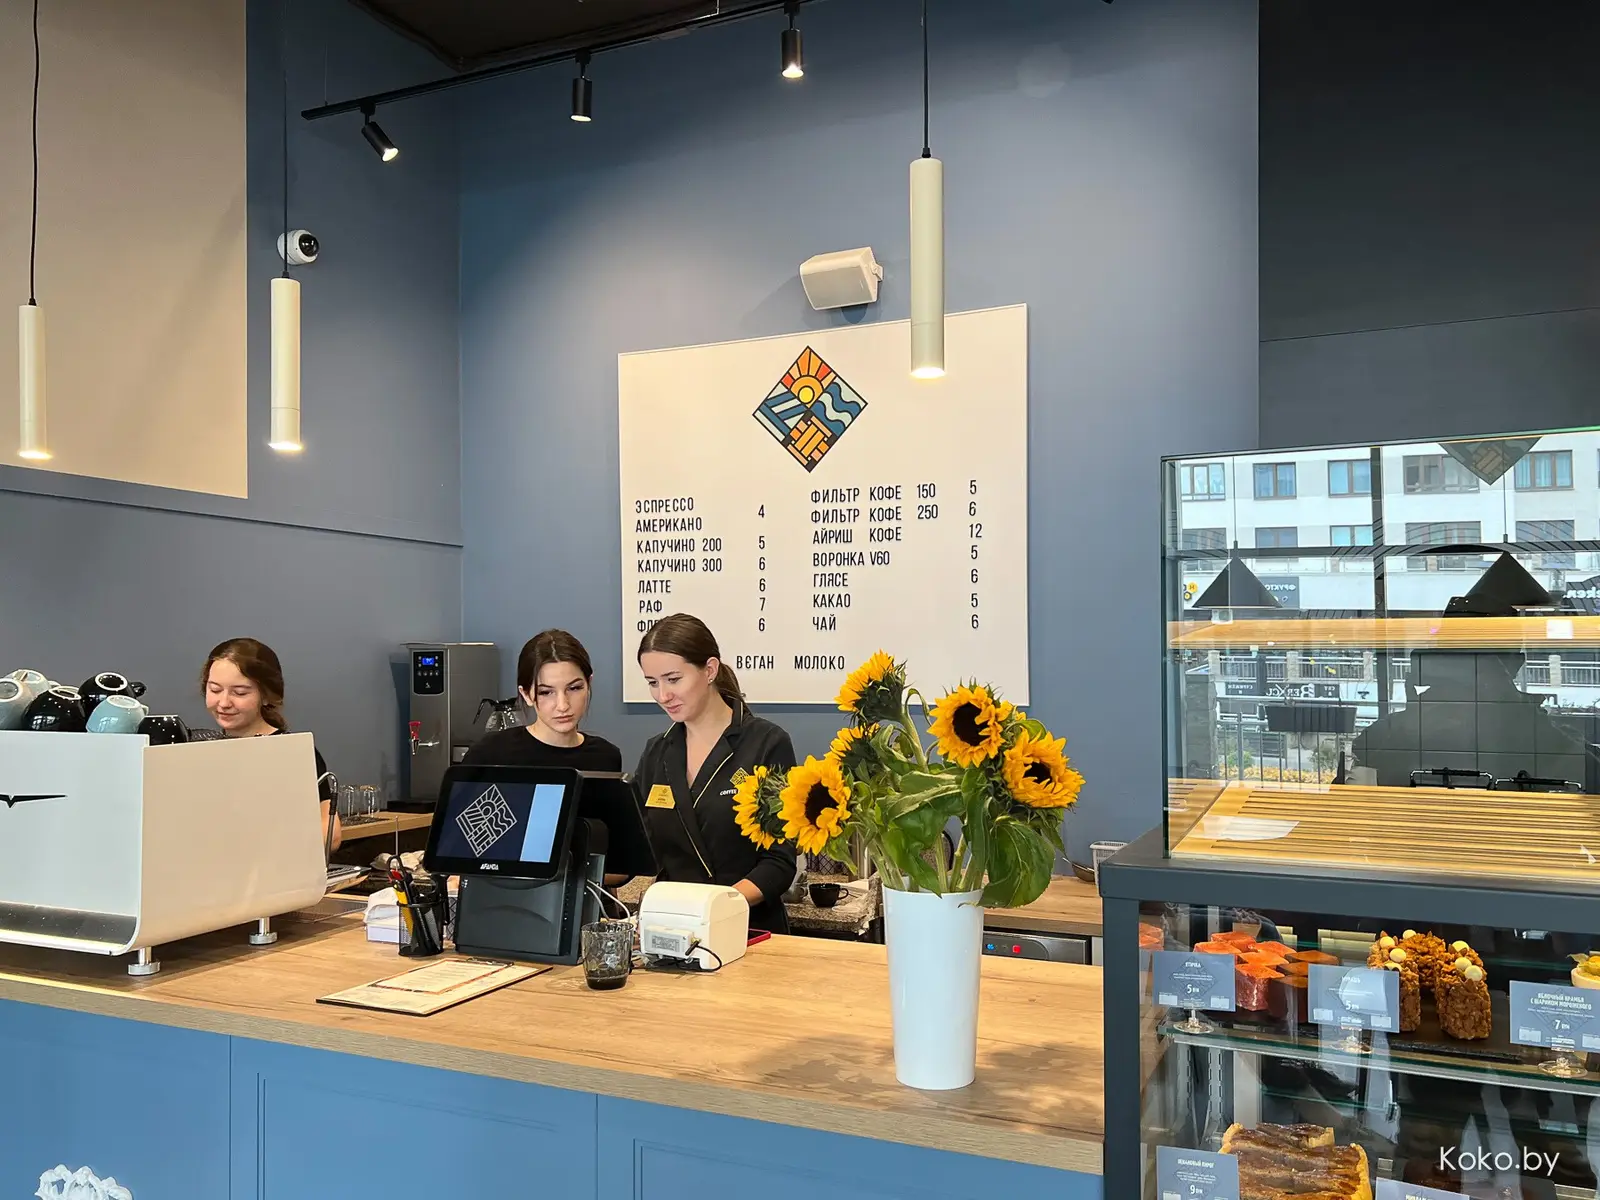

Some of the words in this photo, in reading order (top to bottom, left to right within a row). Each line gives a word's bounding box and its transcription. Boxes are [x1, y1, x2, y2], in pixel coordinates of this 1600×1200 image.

[810, 487, 860, 504] ФИЛЬТР
[869, 485, 902, 501] КОФЕ
[916, 483, 936, 499] 150
[969, 480, 977, 495] 5
[635, 497, 695, 514] ЭСПРЕССО
[757, 504, 765, 518] 4
[810, 508, 860, 524] ФИЛЬТР
[869, 506, 902, 522] КОФЕ
[917, 504, 939, 520] 250
[968, 501, 977, 516] 6
[635, 517, 703, 533] АМЕРИКАНО
[812, 527, 853, 545] АЙРИШ
[869, 526, 902, 543] КОФЕ
[968, 523, 983, 539] 12
[636, 538, 696, 554] КАПУЧИНО
[701, 537, 722, 553] 200
[758, 535, 766, 550] 5
[812, 551, 865, 567] ВОРОНКА
[869, 550, 891, 566] V60
[970, 544, 978, 560] 5
[637, 558, 696, 574] КАПУЧИНО
[701, 557, 723, 573] 300
[758, 556, 766, 571] 6
[637, 579, 672, 594] ЛАТТЕ
[758, 577, 766, 593] 6
[813, 572, 849, 588] ГЛЯСЕ
[970, 568, 979, 584] 6
[638, 599, 663, 614] РАФ
[759, 597, 766, 612] 7
[812, 593, 851, 609] КАКАО
[970, 592, 979, 608] 5
[758, 617, 766, 632] 6
[812, 613, 837, 632] ЧАЙ
[971, 613, 980, 630] 6
[793, 654, 845, 671] МОЛОКО
[1186, 984, 1193, 994] 5
[1345, 1000, 1352, 1010] 5
[1554, 1019, 1561, 1030] 7
[1189, 1184, 1196, 1195] 9
